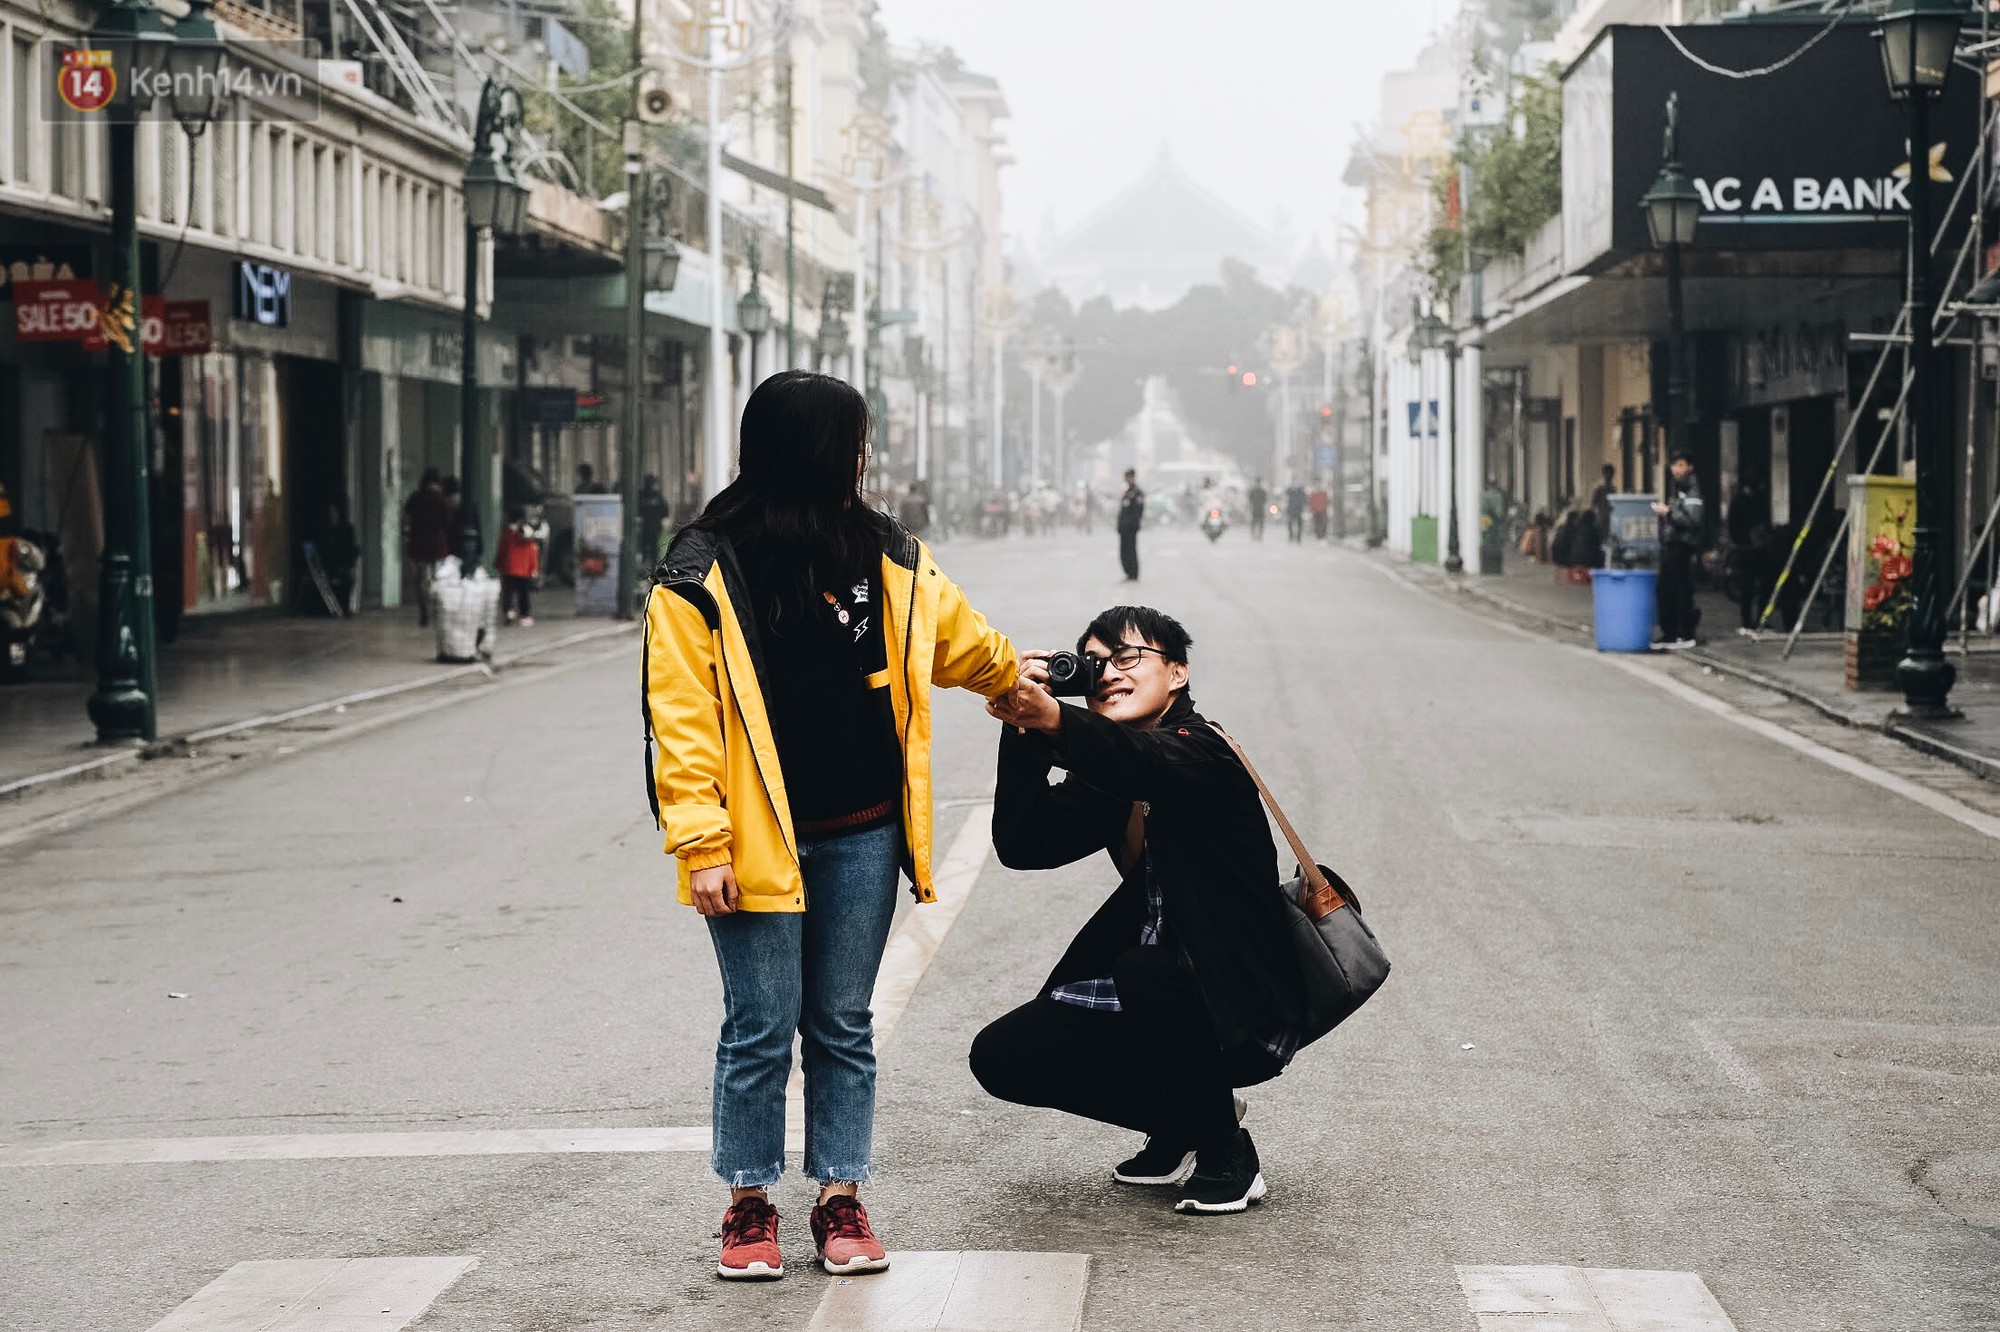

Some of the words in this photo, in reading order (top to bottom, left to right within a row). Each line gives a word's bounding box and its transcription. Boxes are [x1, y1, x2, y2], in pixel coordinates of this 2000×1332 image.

[1693, 177, 1742, 211] AC
[1750, 177, 1784, 211] A
[1793, 177, 1912, 211] BANK
